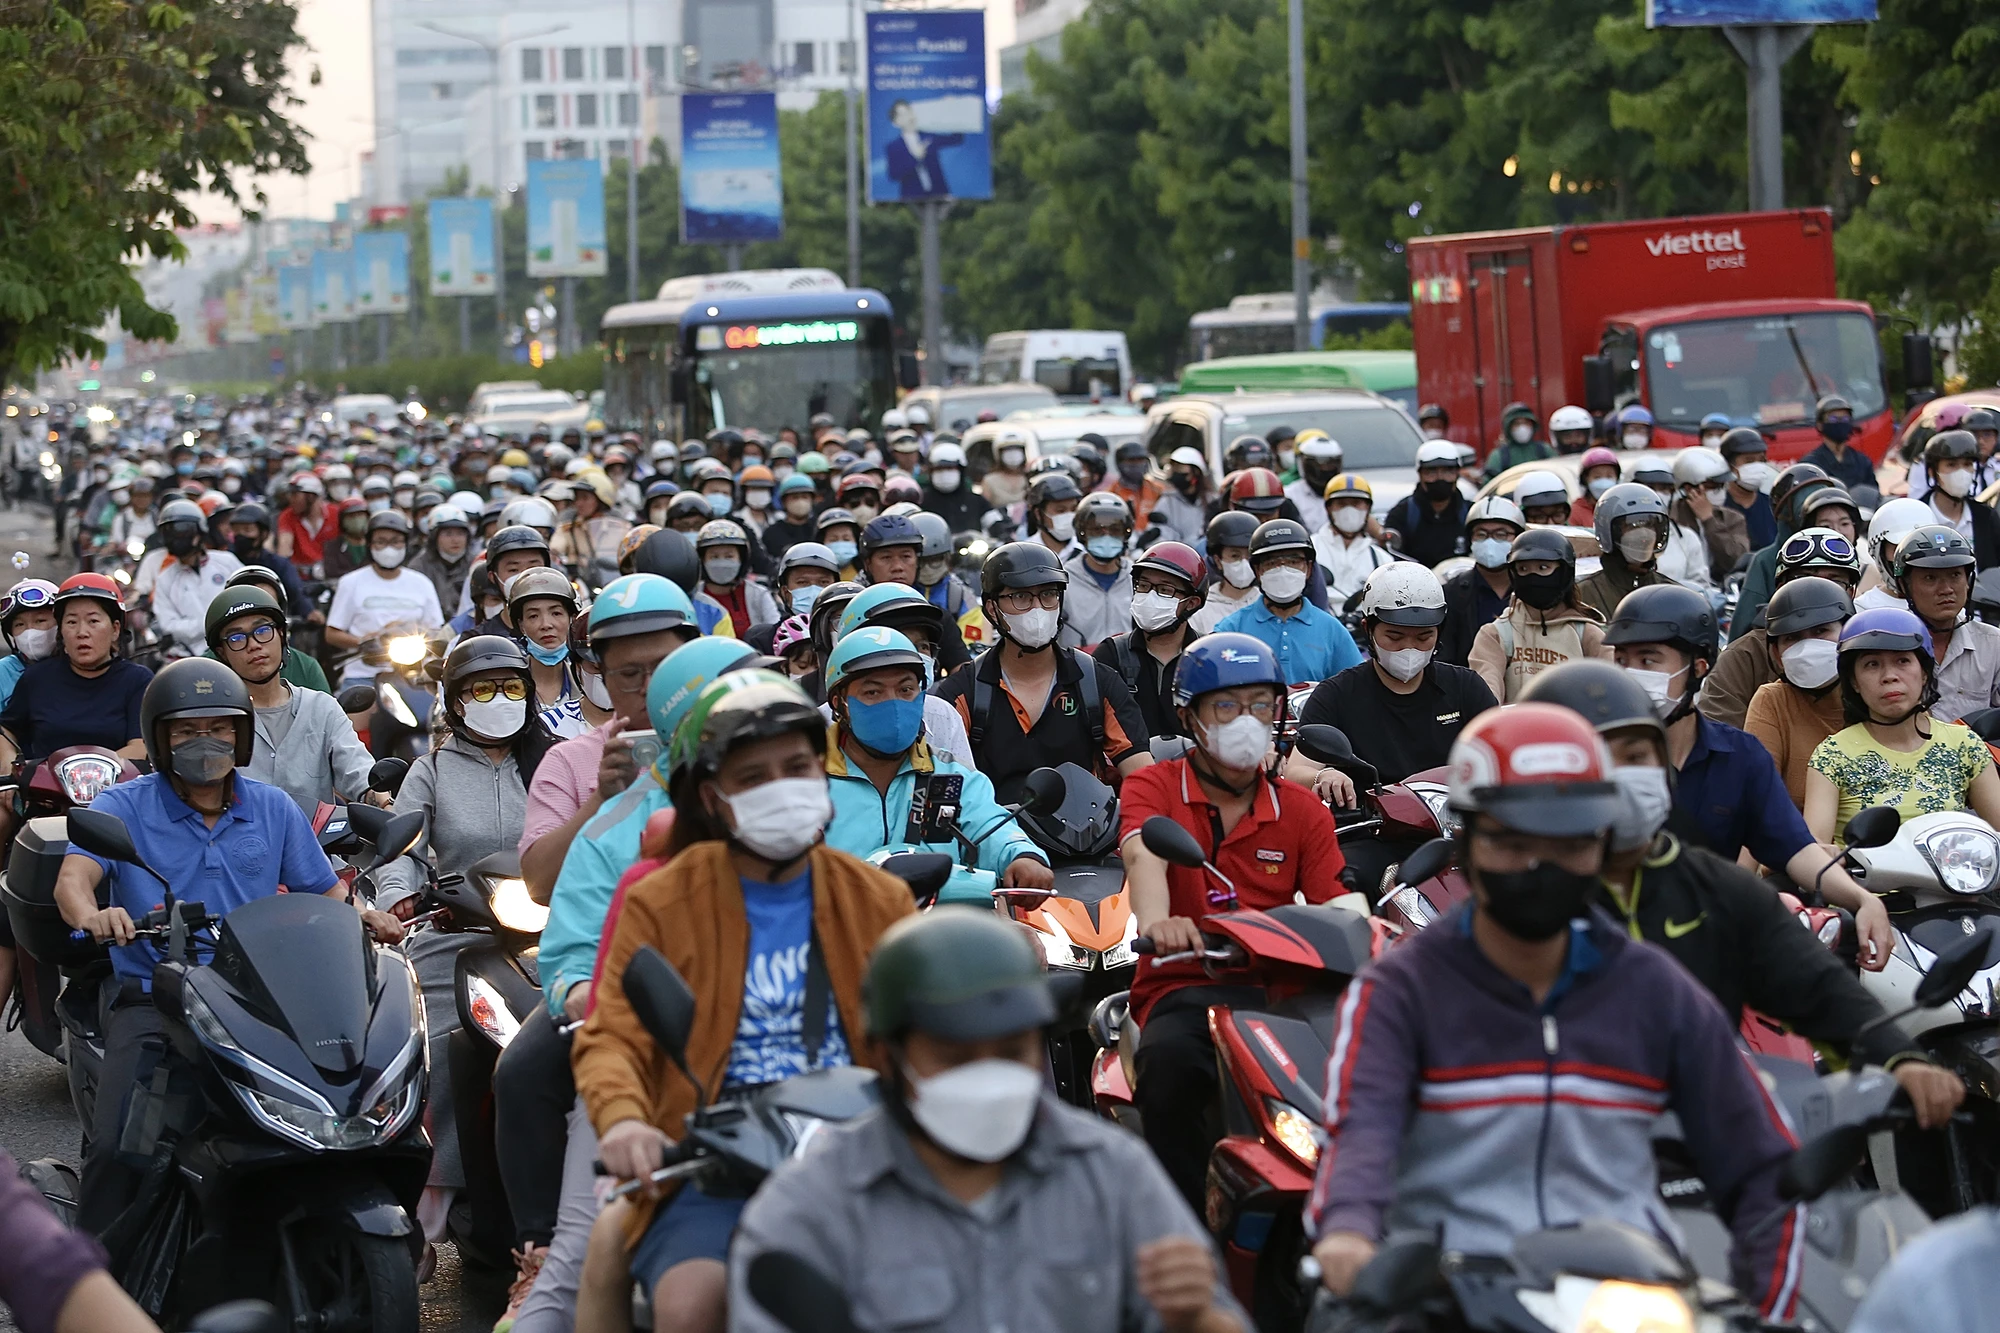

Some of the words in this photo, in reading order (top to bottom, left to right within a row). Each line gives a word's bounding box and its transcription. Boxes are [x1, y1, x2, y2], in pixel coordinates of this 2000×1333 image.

[1645, 228, 1746, 256] viettel
[1706, 252, 1745, 272] post
[1060, 696, 1075, 712] TH
[911, 786, 927, 825] FILA
[315, 1038, 354, 1047] HONDA
